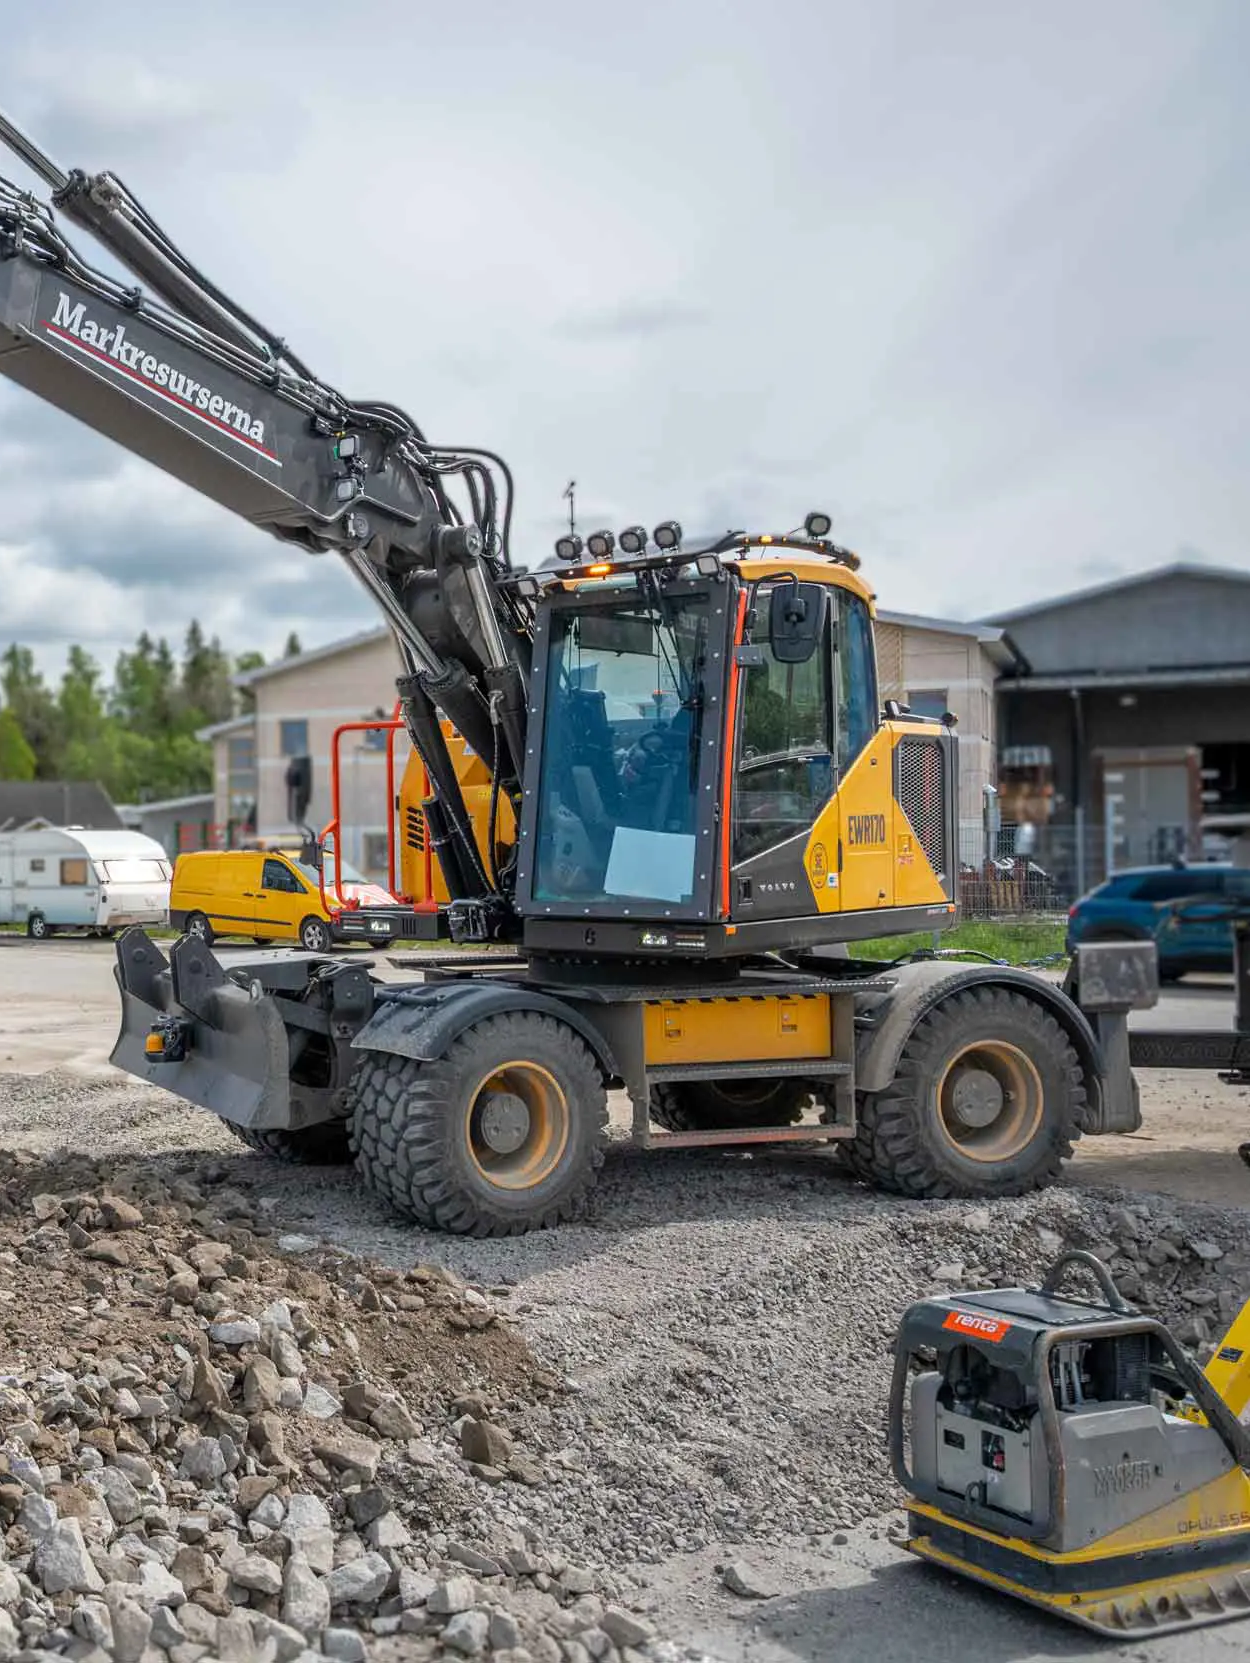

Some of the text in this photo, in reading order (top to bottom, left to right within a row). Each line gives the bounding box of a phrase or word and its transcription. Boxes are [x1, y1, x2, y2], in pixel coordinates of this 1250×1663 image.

[52, 291, 265, 444] Markresurserna
[848, 814, 885, 844] EWR170
[758, 882, 796, 892] VOLVO
[954, 1314, 998, 1333] renta
